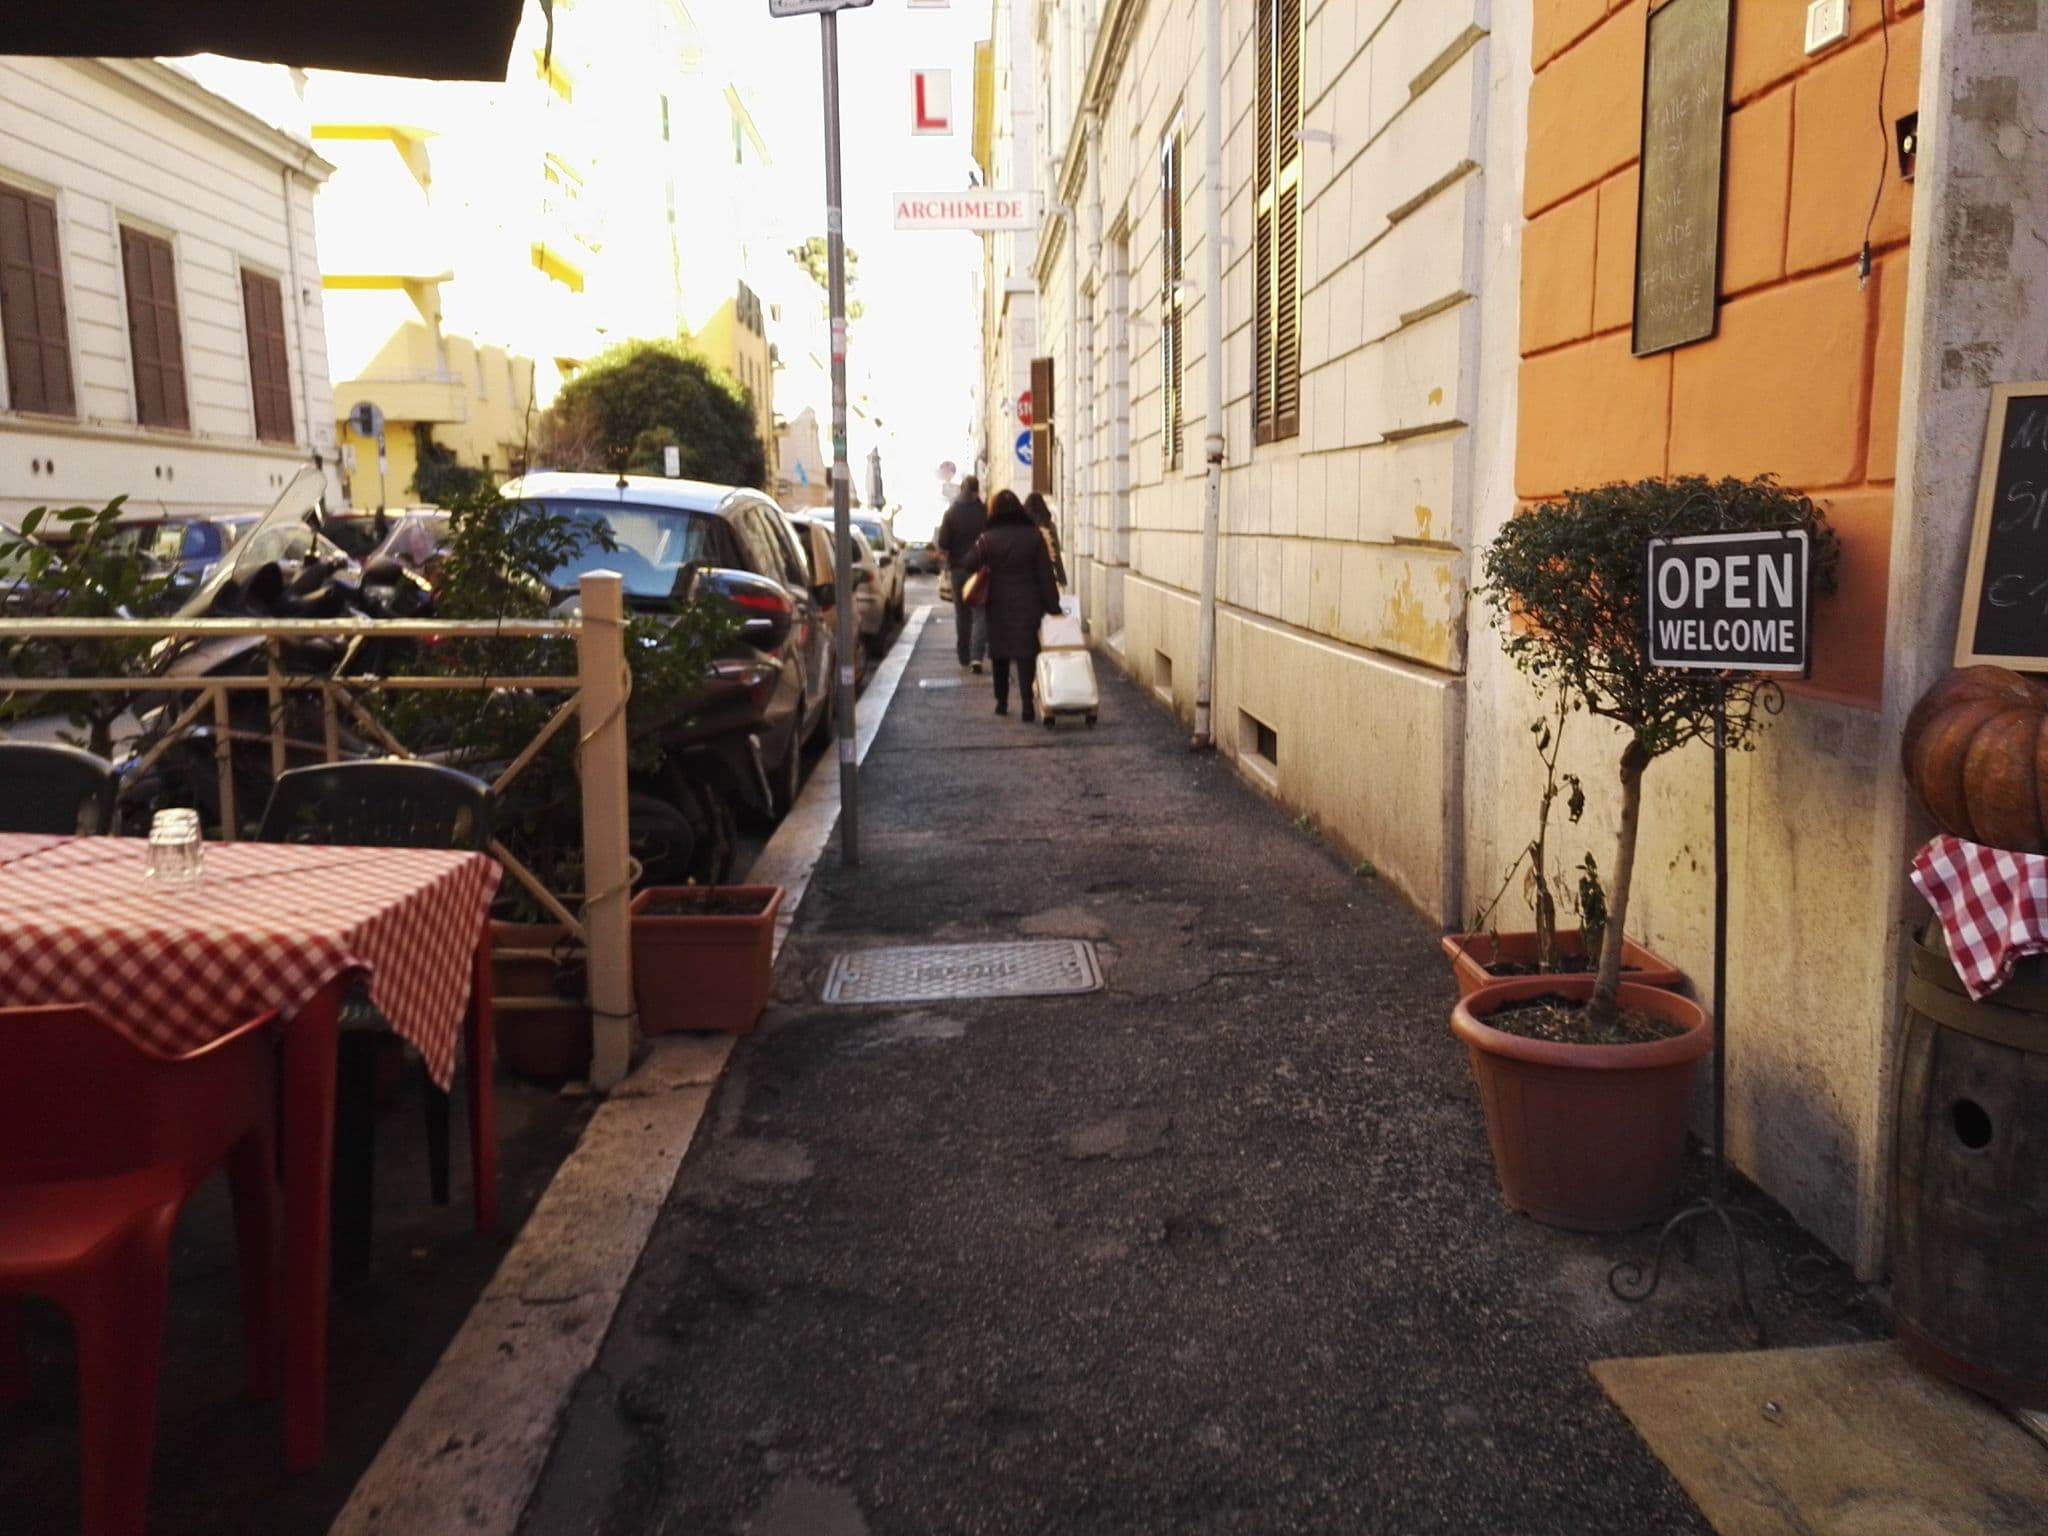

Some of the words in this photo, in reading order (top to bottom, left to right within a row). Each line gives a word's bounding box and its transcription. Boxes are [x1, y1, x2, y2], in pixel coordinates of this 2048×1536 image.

[914, 73, 948, 129] L
[896, 201, 1024, 220] ARCHIMEDE
[1658, 553, 1793, 609] OPEN
[1659, 619, 1795, 653] WELCOME
